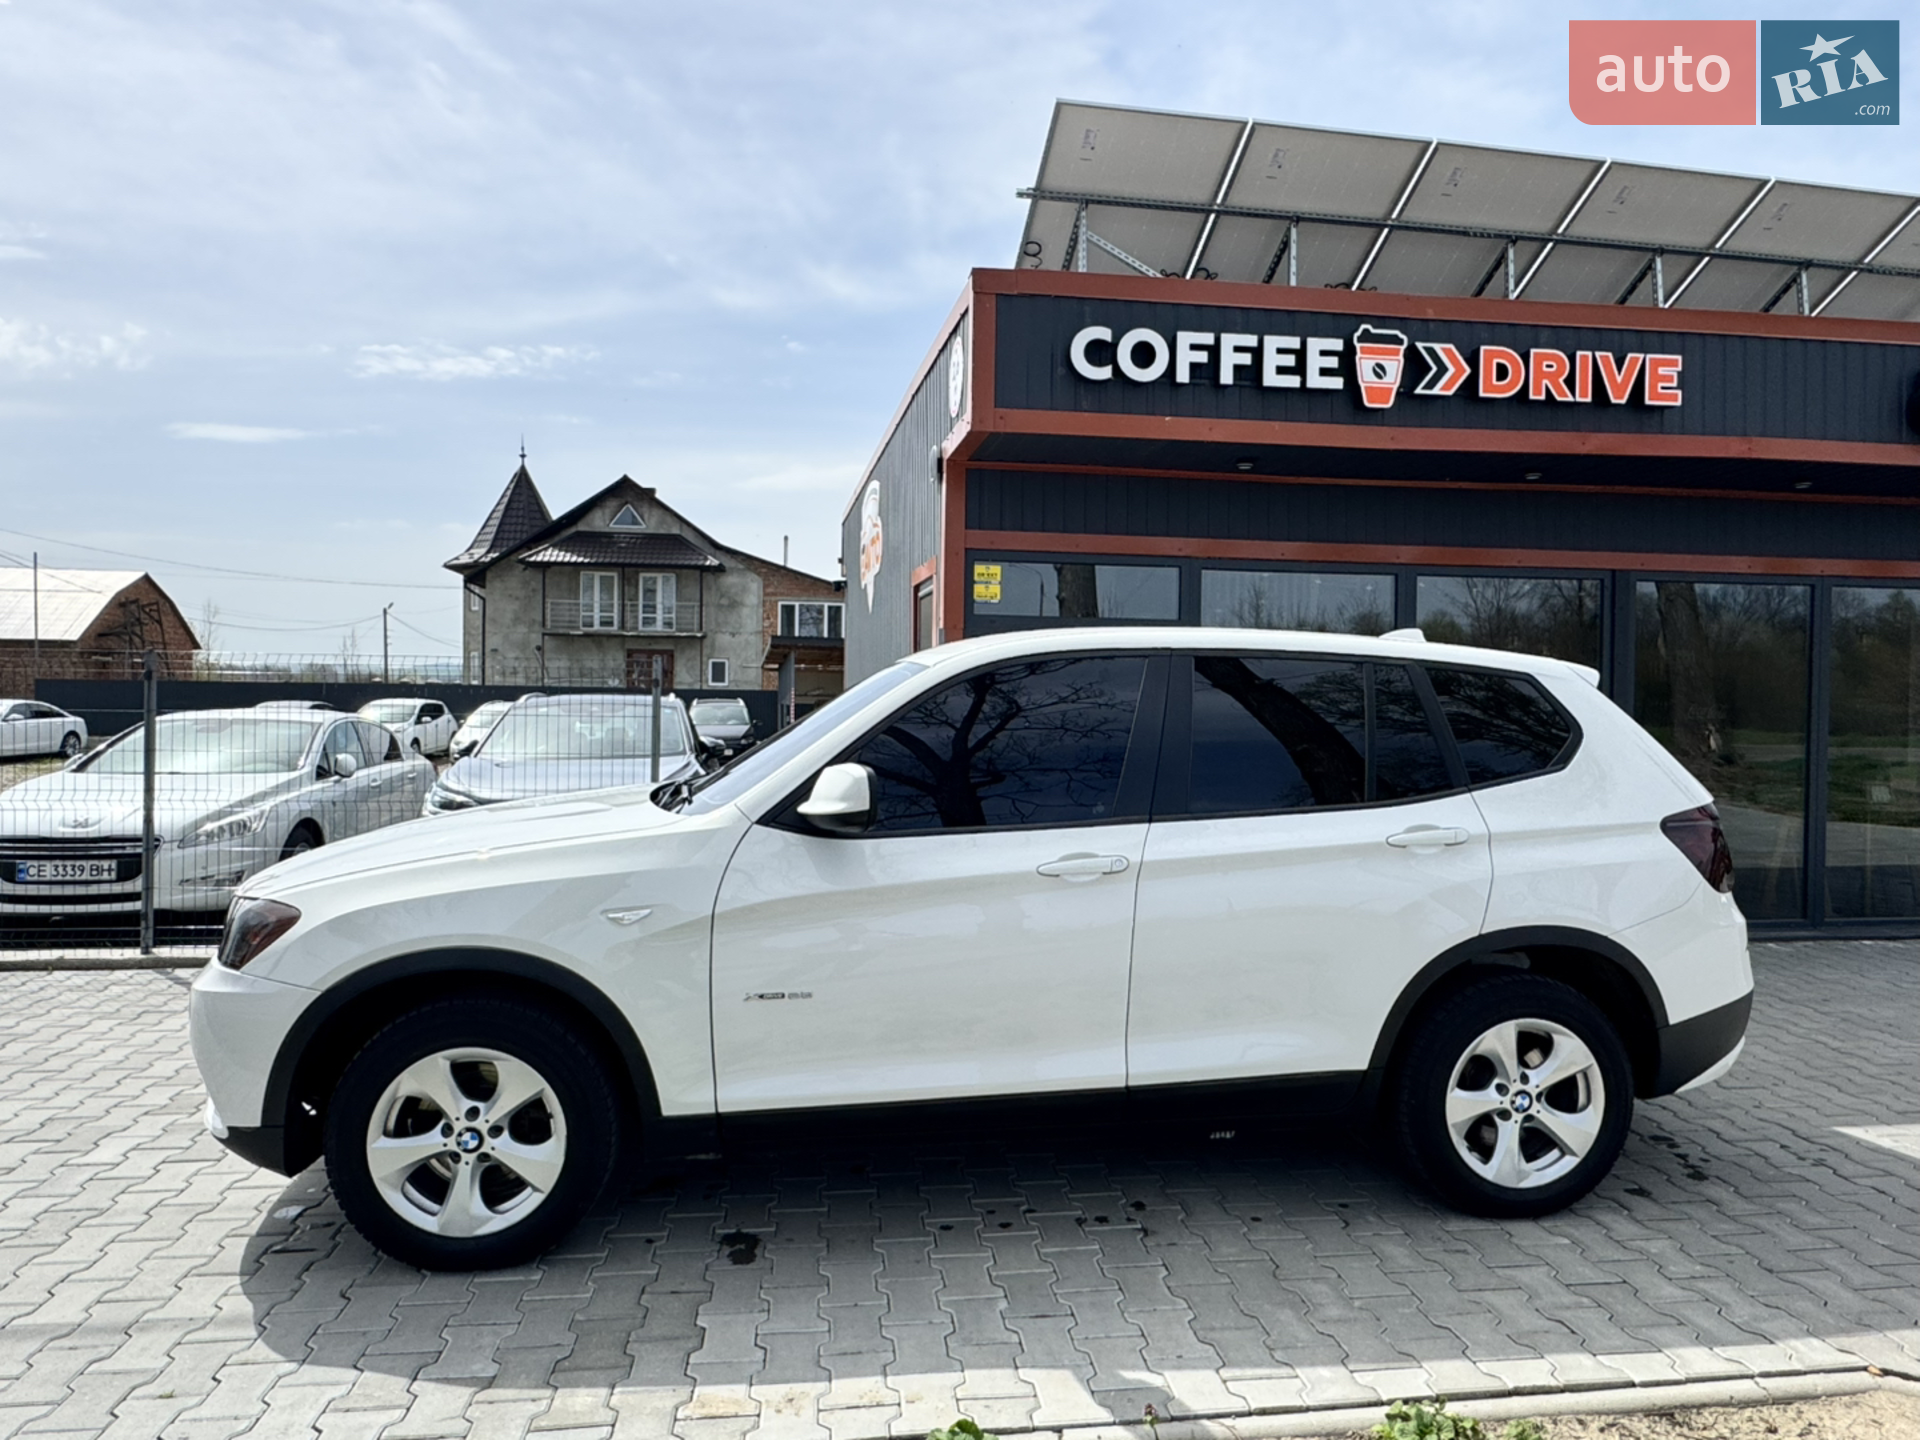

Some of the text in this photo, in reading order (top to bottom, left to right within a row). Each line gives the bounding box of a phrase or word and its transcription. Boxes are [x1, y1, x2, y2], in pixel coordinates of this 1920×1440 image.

[1069, 325, 1684, 408] COFFEE DRIVE
[26, 864, 47, 878] CE
[51, 864, 85, 877] 3339
[89, 864, 113, 877] BH
